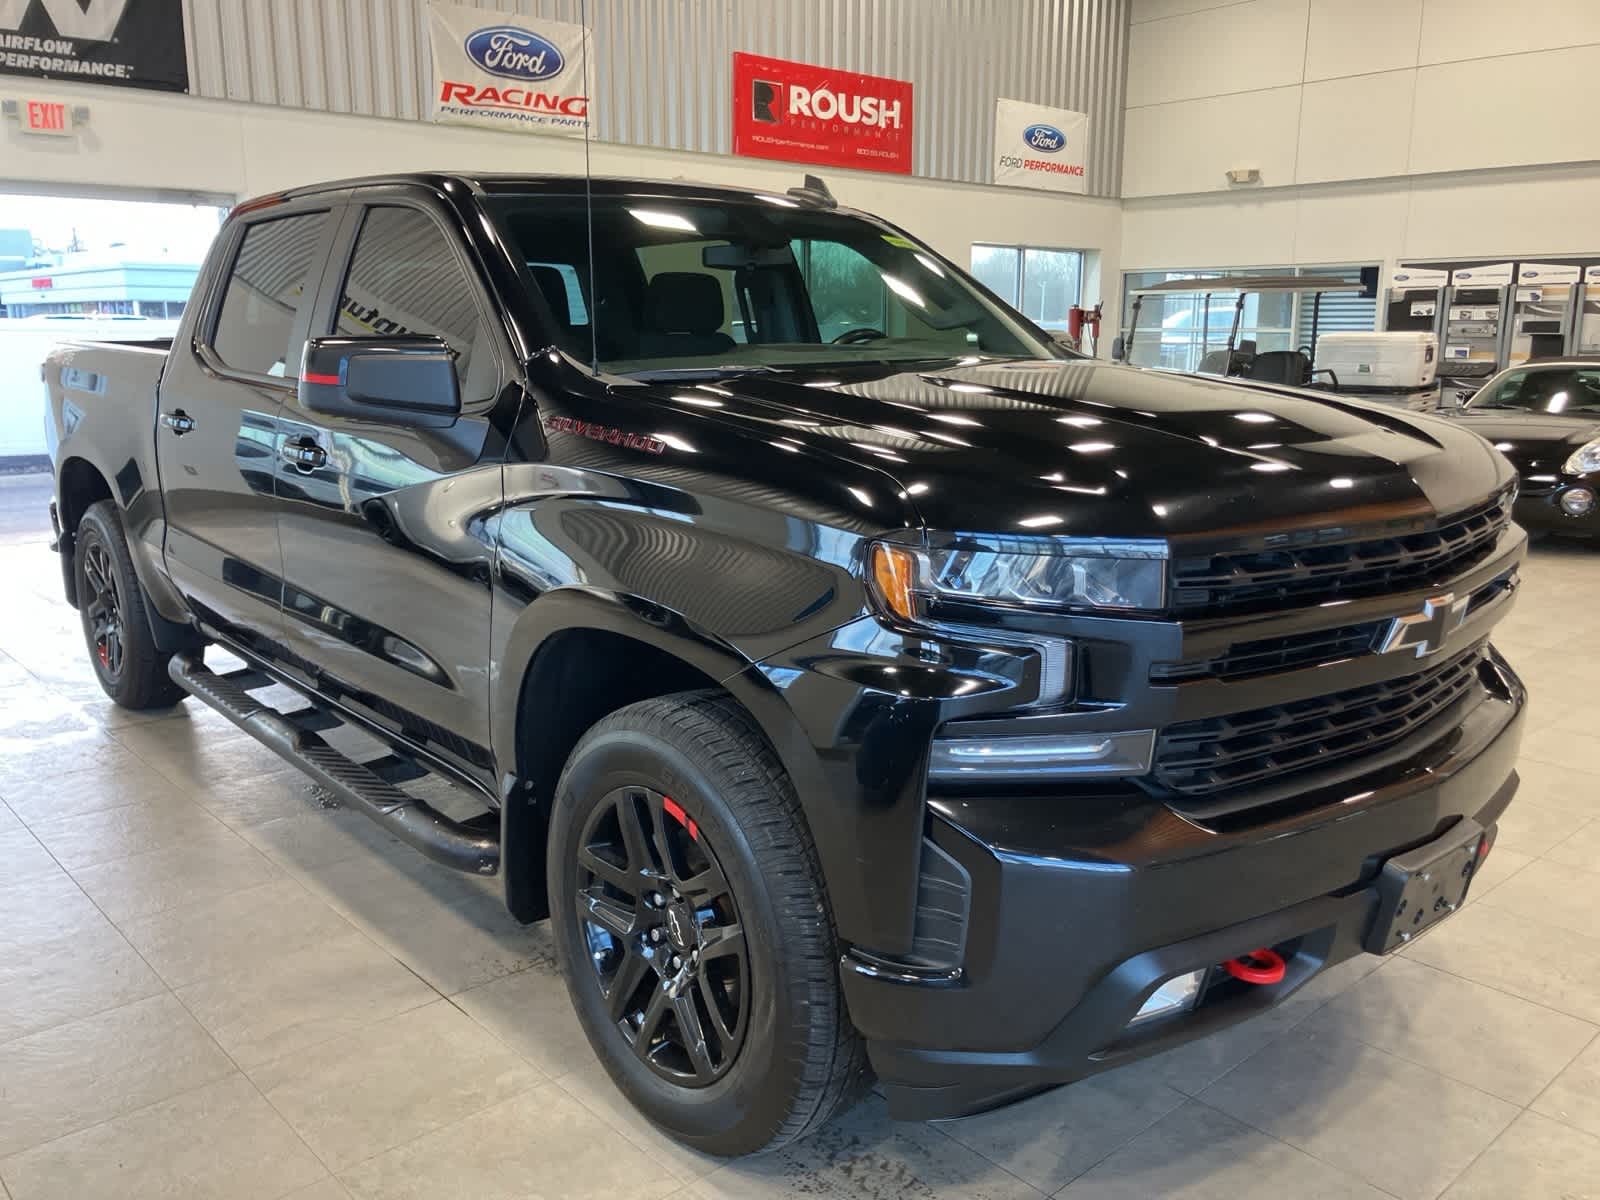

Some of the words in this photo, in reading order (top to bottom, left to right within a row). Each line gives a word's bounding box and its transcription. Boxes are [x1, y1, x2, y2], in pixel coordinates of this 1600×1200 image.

[485, 33, 546, 74] Ford
[440, 81, 590, 117] RACING
[789, 80, 901, 129] ROUSH
[28, 101, 65, 130] EXIT
[440, 105, 549, 124] PERFORMANCE
[1031, 128, 1058, 149] Ford
[999, 155, 1023, 168] FORD
[1023, 159, 1084, 177] PERFORMANCE
